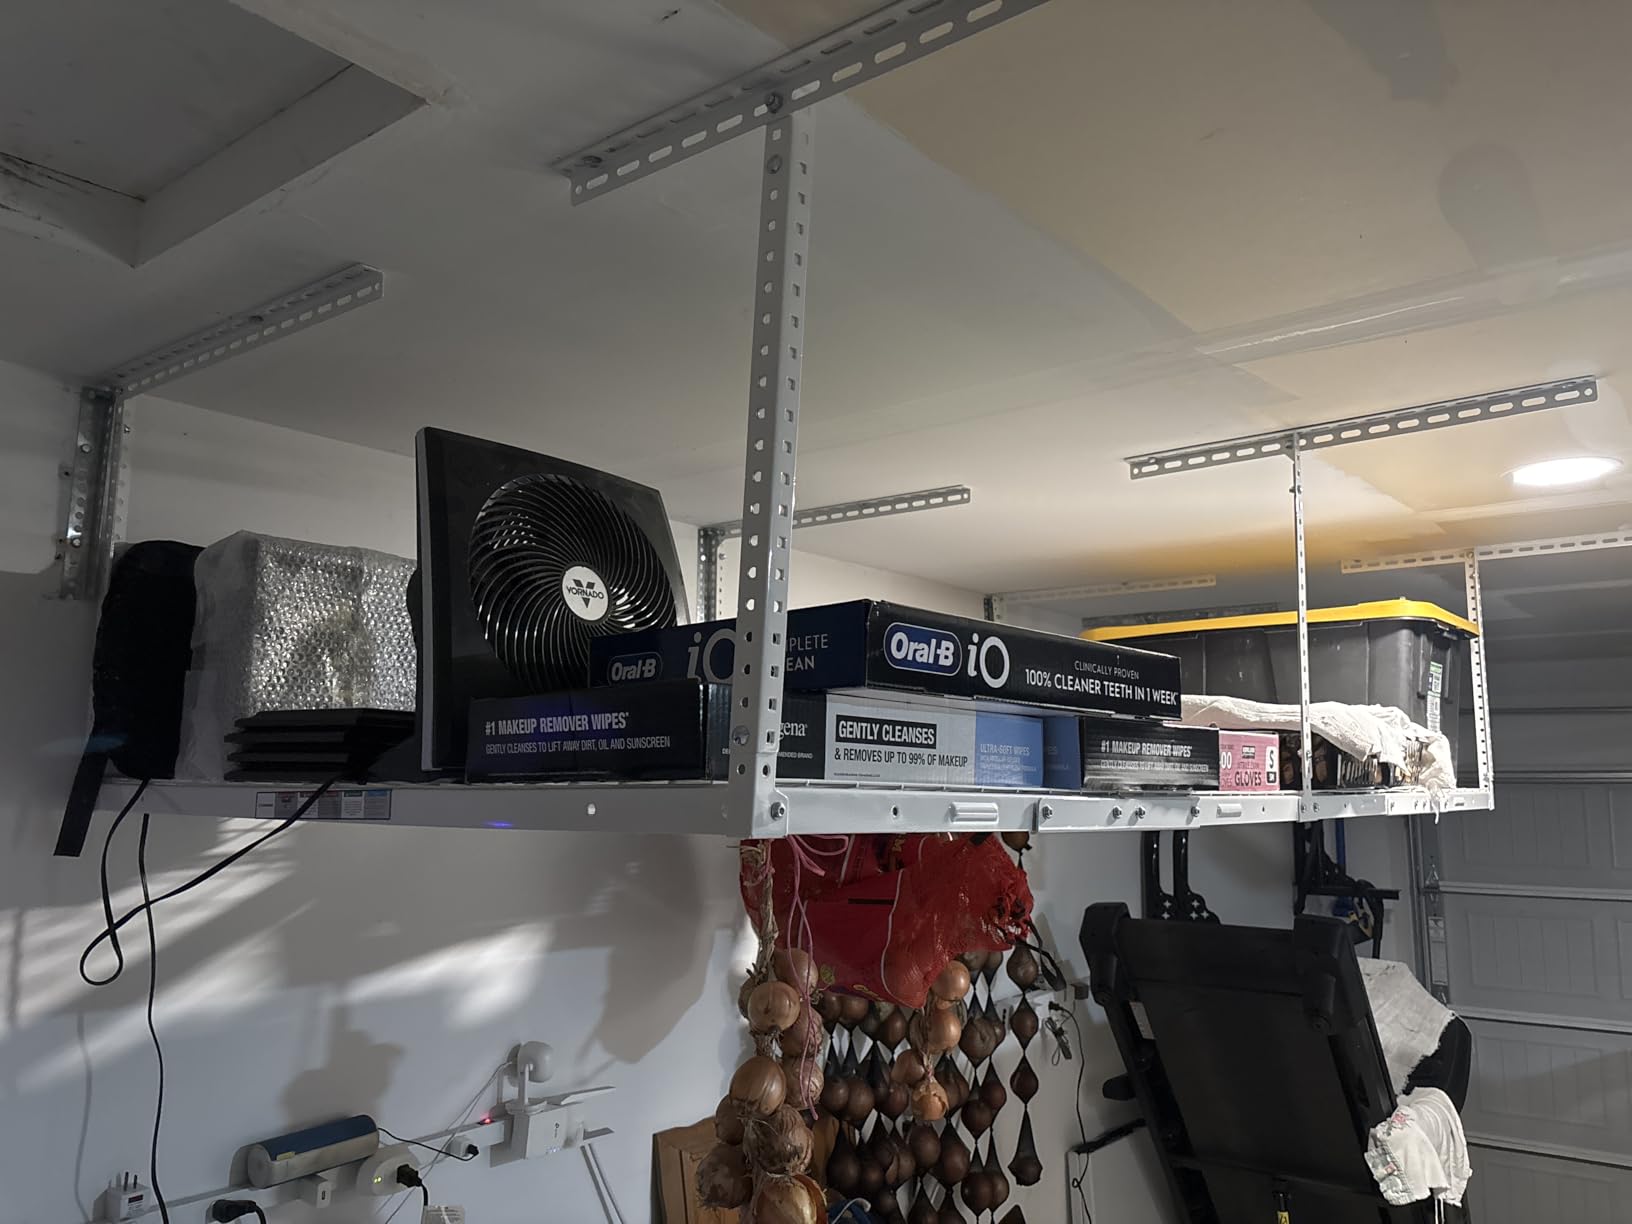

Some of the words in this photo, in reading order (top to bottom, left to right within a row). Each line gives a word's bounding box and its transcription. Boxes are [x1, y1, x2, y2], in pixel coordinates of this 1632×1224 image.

[566, 585, 605, 599] VORNADO
[785, 634, 829, 652] PLETE
[611, 658, 657, 681] Oral-B
[890, 632, 954, 666] Oral-B
[967, 632, 1010, 689] iO
[1074, 660, 1112, 676] CLINICALLY
[1114, 667, 1140, 680] PROVEN
[1025, 668, 1052, 688] 100%
[1054, 673, 1101, 695] CLEANER
[1103, 681, 1132, 700] TEETH
[1134, 686, 1145, 701] IN
[1146, 687, 1151, 702] 1
[485, 722, 496, 736] #1
[498, 718, 537, 735] MAKEUP
[539, 714, 589, 733] REMOVER
[838, 720, 880, 740] GENTLY
[881, 724, 935, 745] CLEANSES
[485, 743, 507, 754] GENTLY
[507, 741, 537, 753] CLEANSES
[538, 741, 546, 752] TO
[548, 740, 561, 752] LIFT
[562, 740, 580, 752] AWAY
[581, 739, 598, 752] DIRT,
[598, 738, 610, 751] OIL
[610, 737, 625, 750] AND
[626, 735, 671, 749] SUNSCREEN
[979, 743, 1012, 755] ULTRA-SOFT
[1101, 739, 1110, 753] #1
[1112, 740, 1140, 755] MAKEUP
[1141, 742, 1171, 757] REMOVER
[834, 747, 842, 760] &
[843, 748, 882, 763] REMOVES
[884, 751, 895, 763] UP
[896, 752, 907, 764] TO
[908, 753, 926, 766] 99%
[927, 754, 937, 766] OF
[938, 755, 969, 767] MAKEUP
[1219, 751, 1232, 769] 00
[1269, 750, 1274, 769] S
[1234, 771, 1262, 787] GLOVES
